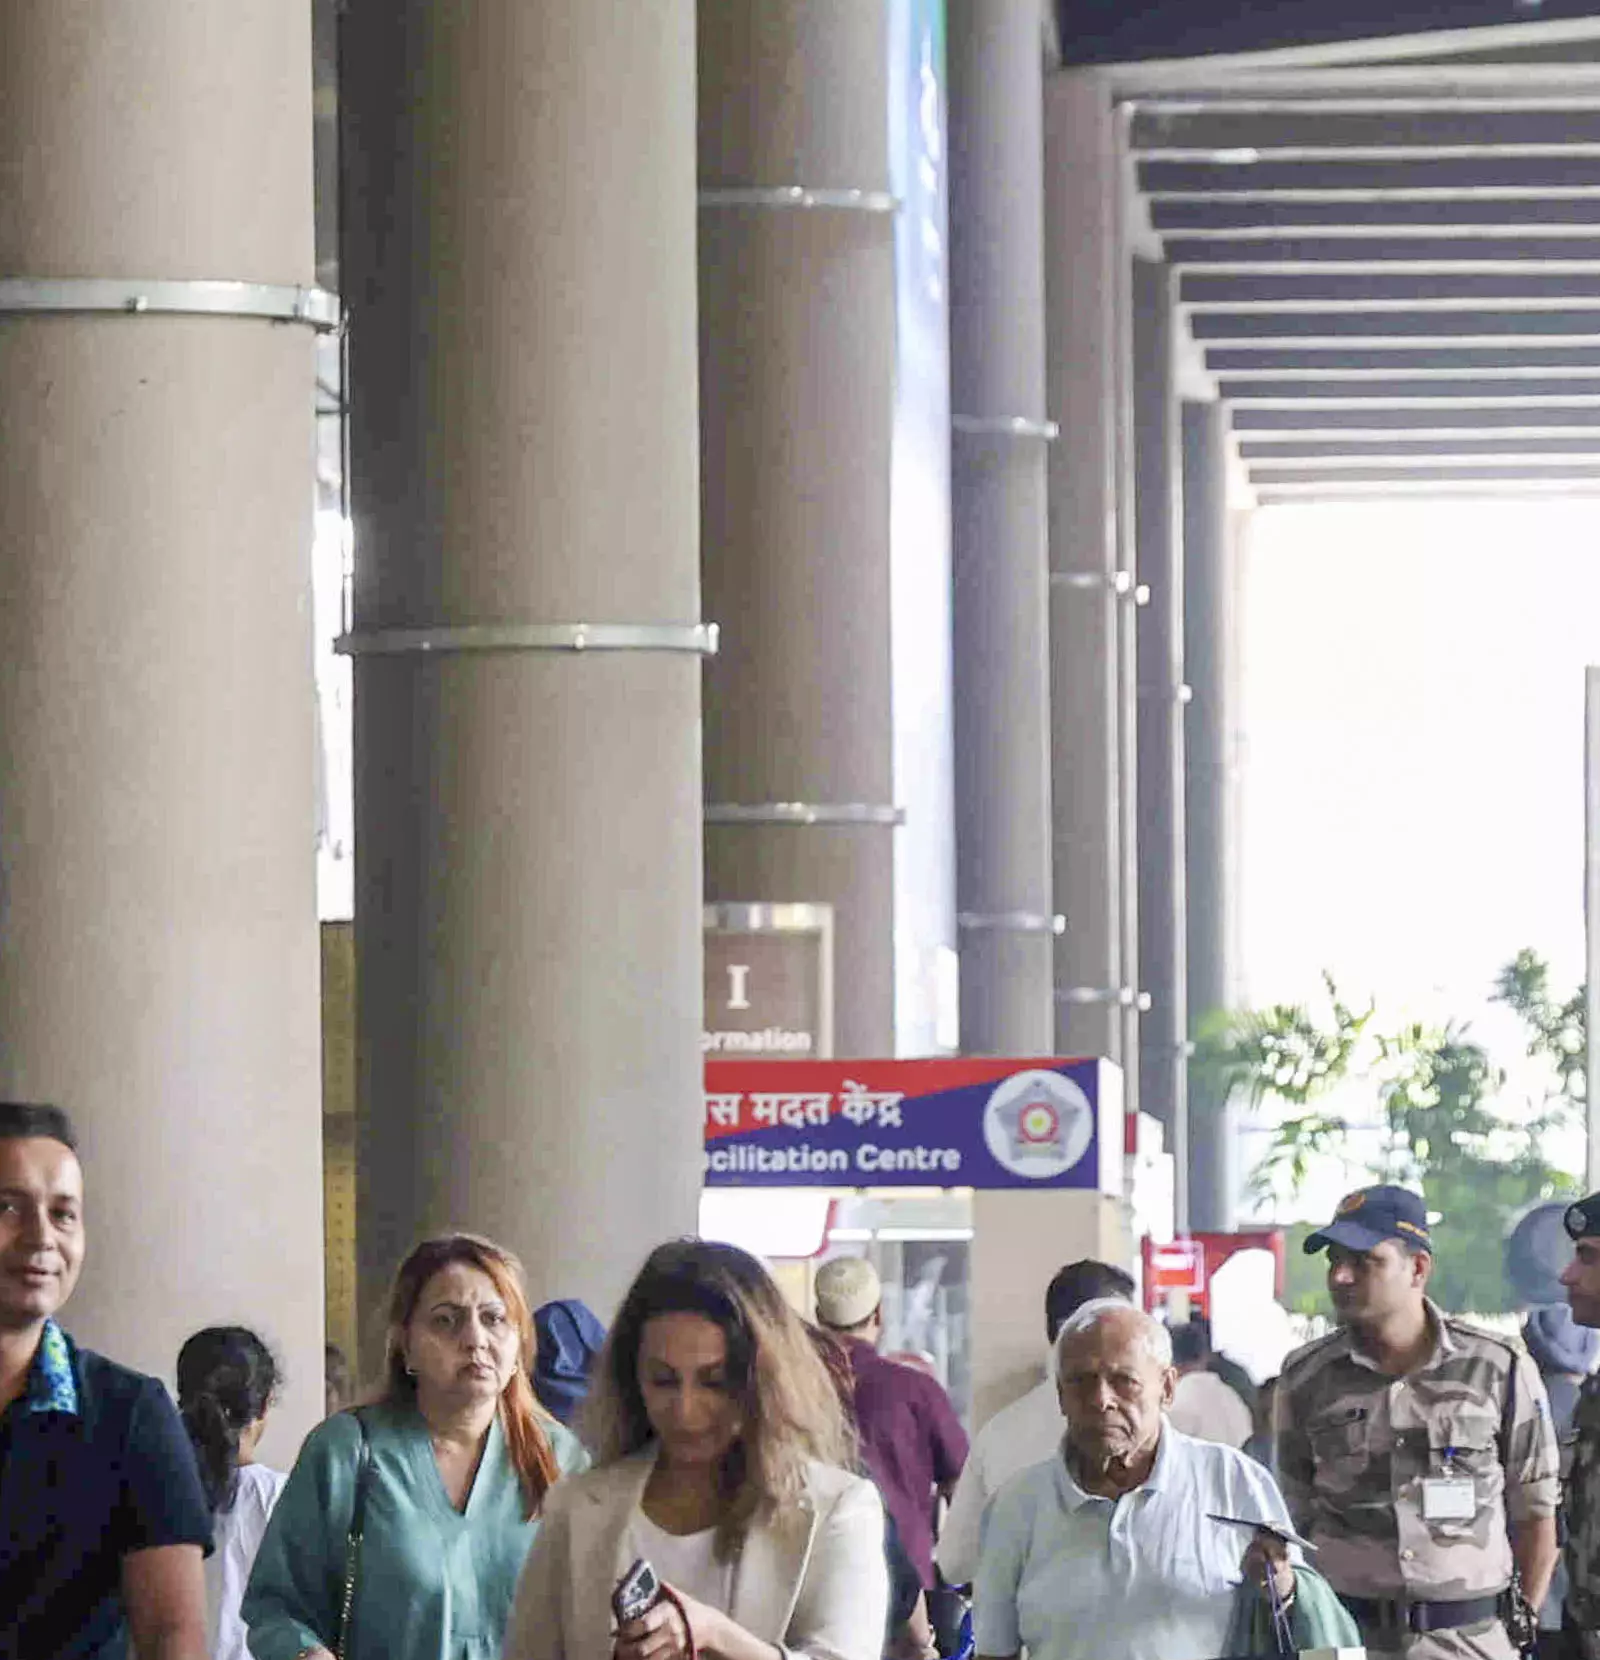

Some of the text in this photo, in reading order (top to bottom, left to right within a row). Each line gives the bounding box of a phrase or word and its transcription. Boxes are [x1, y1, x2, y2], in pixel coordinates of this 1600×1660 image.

[726, 964, 750, 1009] I
[749, 1092, 833, 1128] मदत
[839, 1079, 905, 1127] केंद्र
[855, 1144, 962, 1172] Centre
